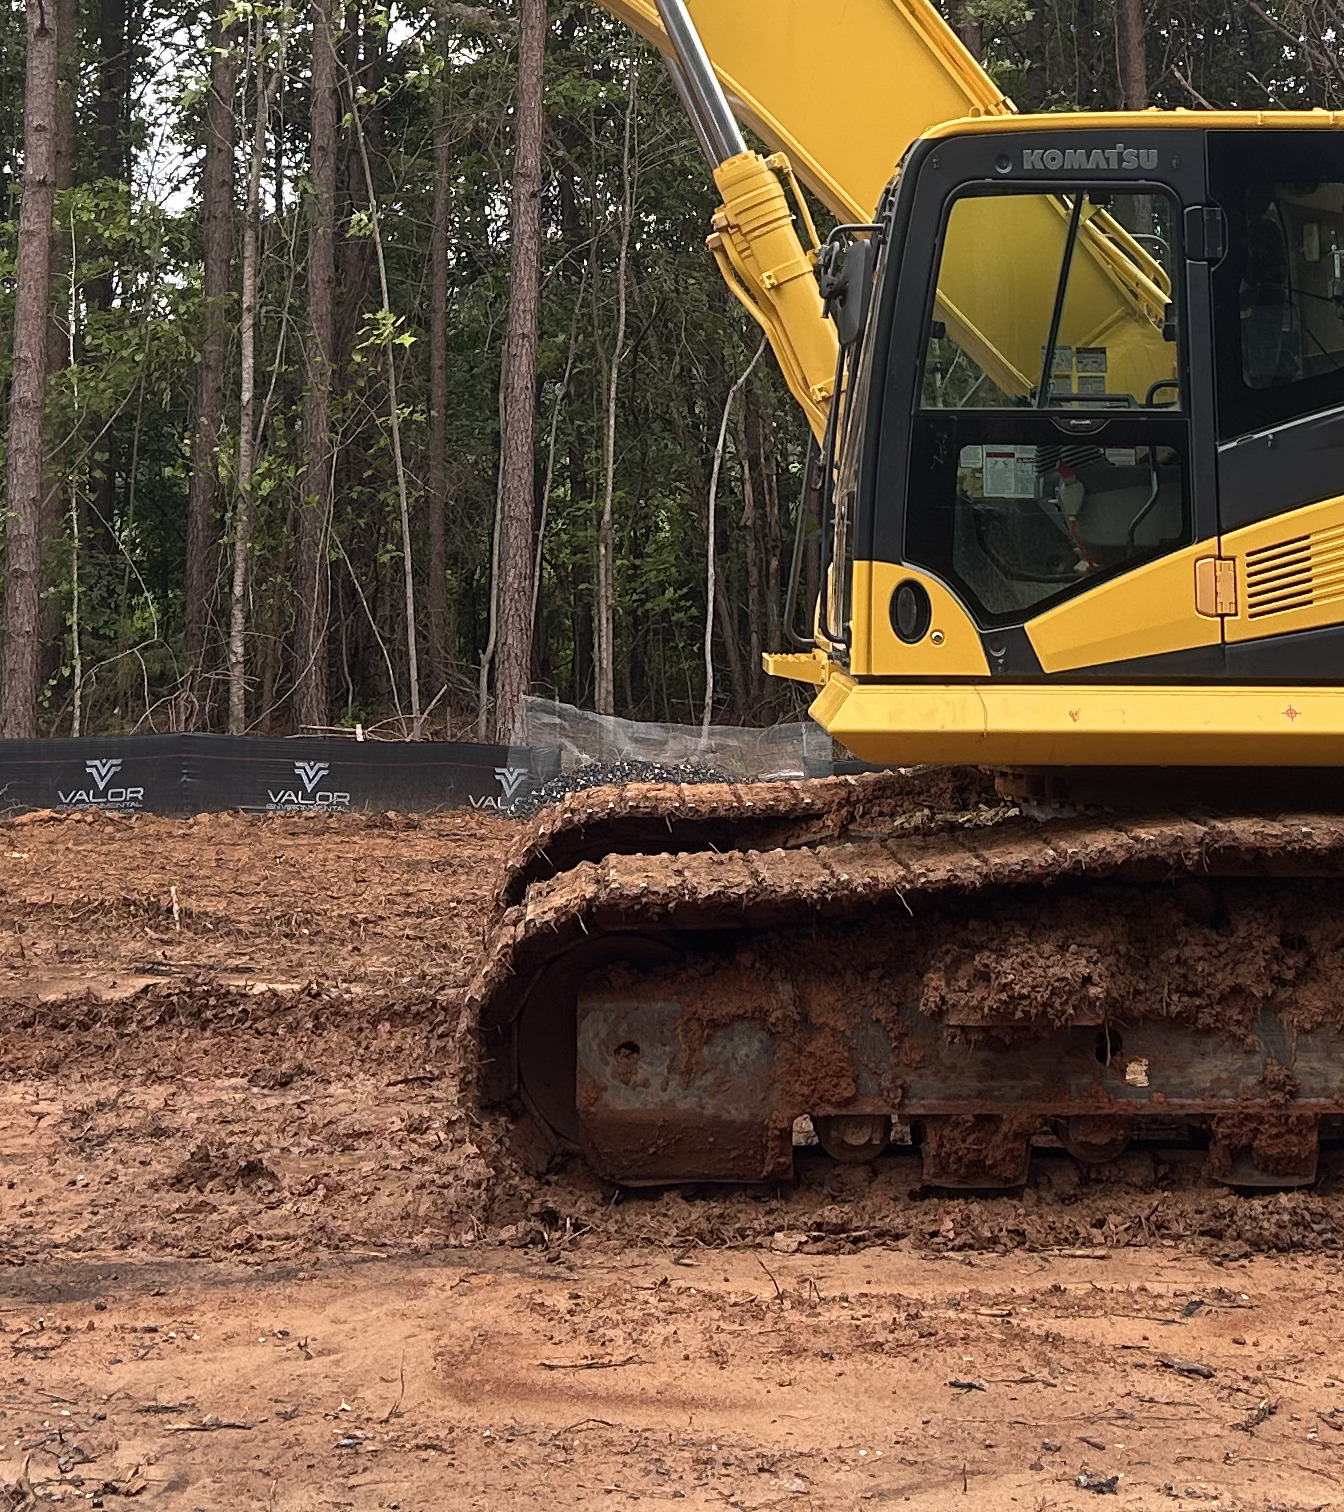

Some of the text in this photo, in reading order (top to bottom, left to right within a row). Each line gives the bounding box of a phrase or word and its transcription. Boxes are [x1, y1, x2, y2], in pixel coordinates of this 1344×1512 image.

[1022, 143, 1158, 170] KOMATSU
[57, 787, 144, 803] VALOR
[267, 789, 351, 806] VALOR
